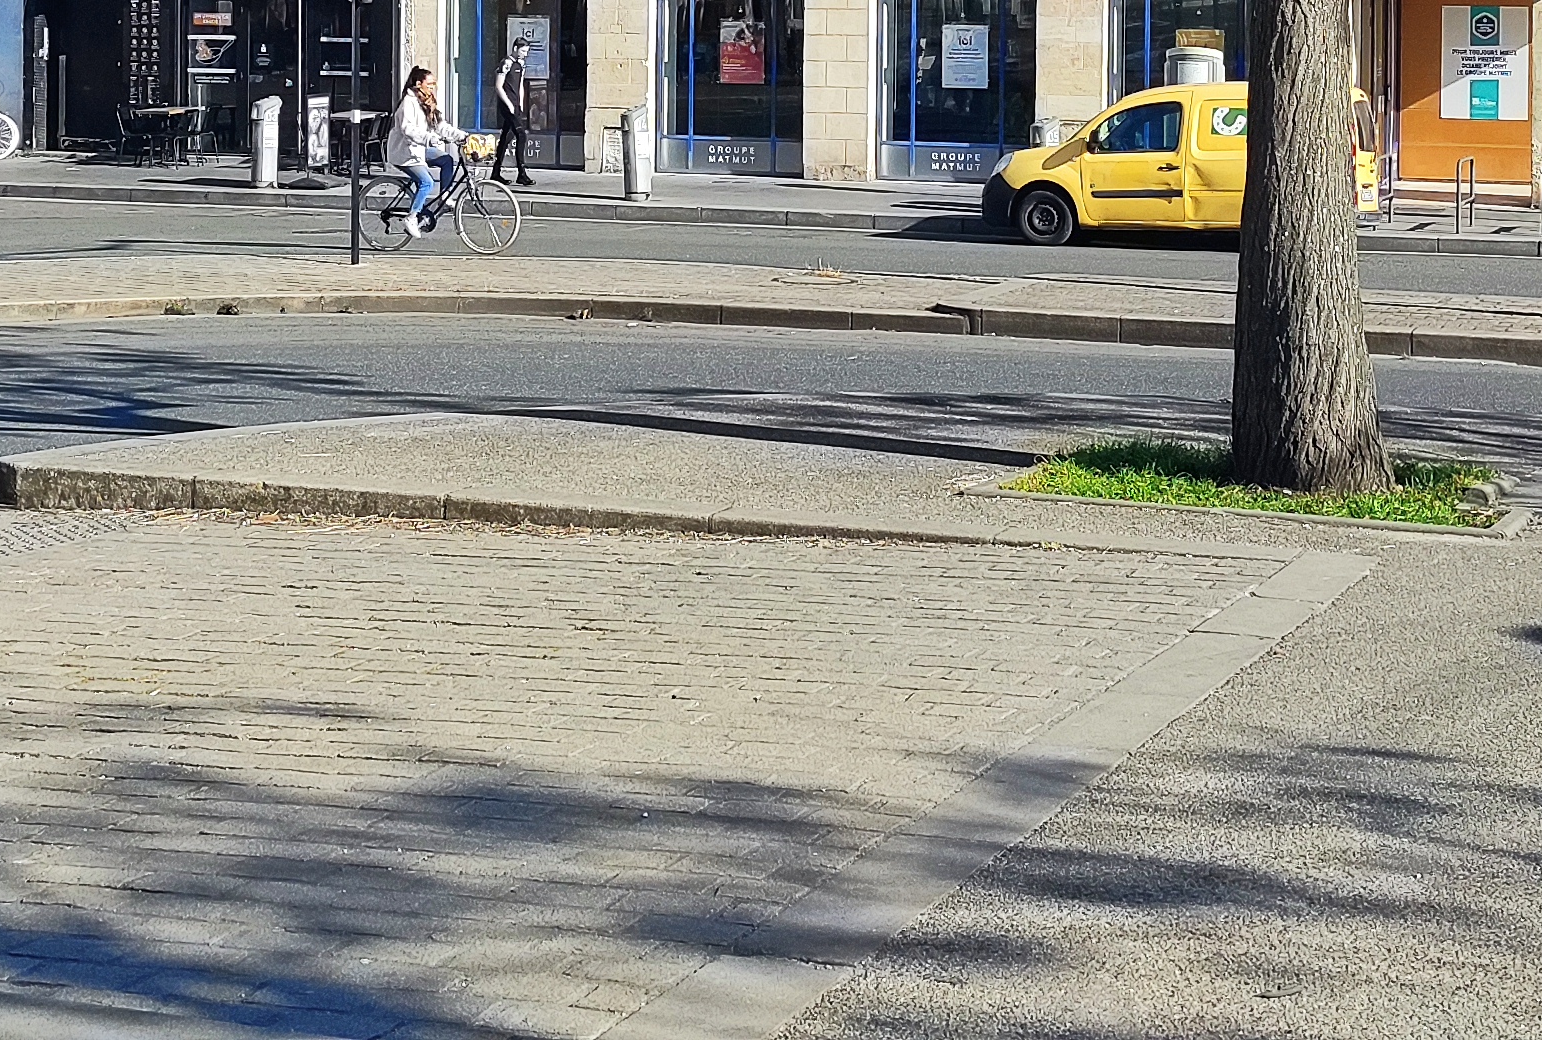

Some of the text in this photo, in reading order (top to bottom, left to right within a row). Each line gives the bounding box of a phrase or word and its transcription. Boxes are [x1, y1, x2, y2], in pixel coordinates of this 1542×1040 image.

[708, 144, 755, 154] GROUPE
[708, 154, 755, 165] MATMUT
[931, 152, 981, 161] GROUPE
[931, 162, 981, 172] MATMUT
